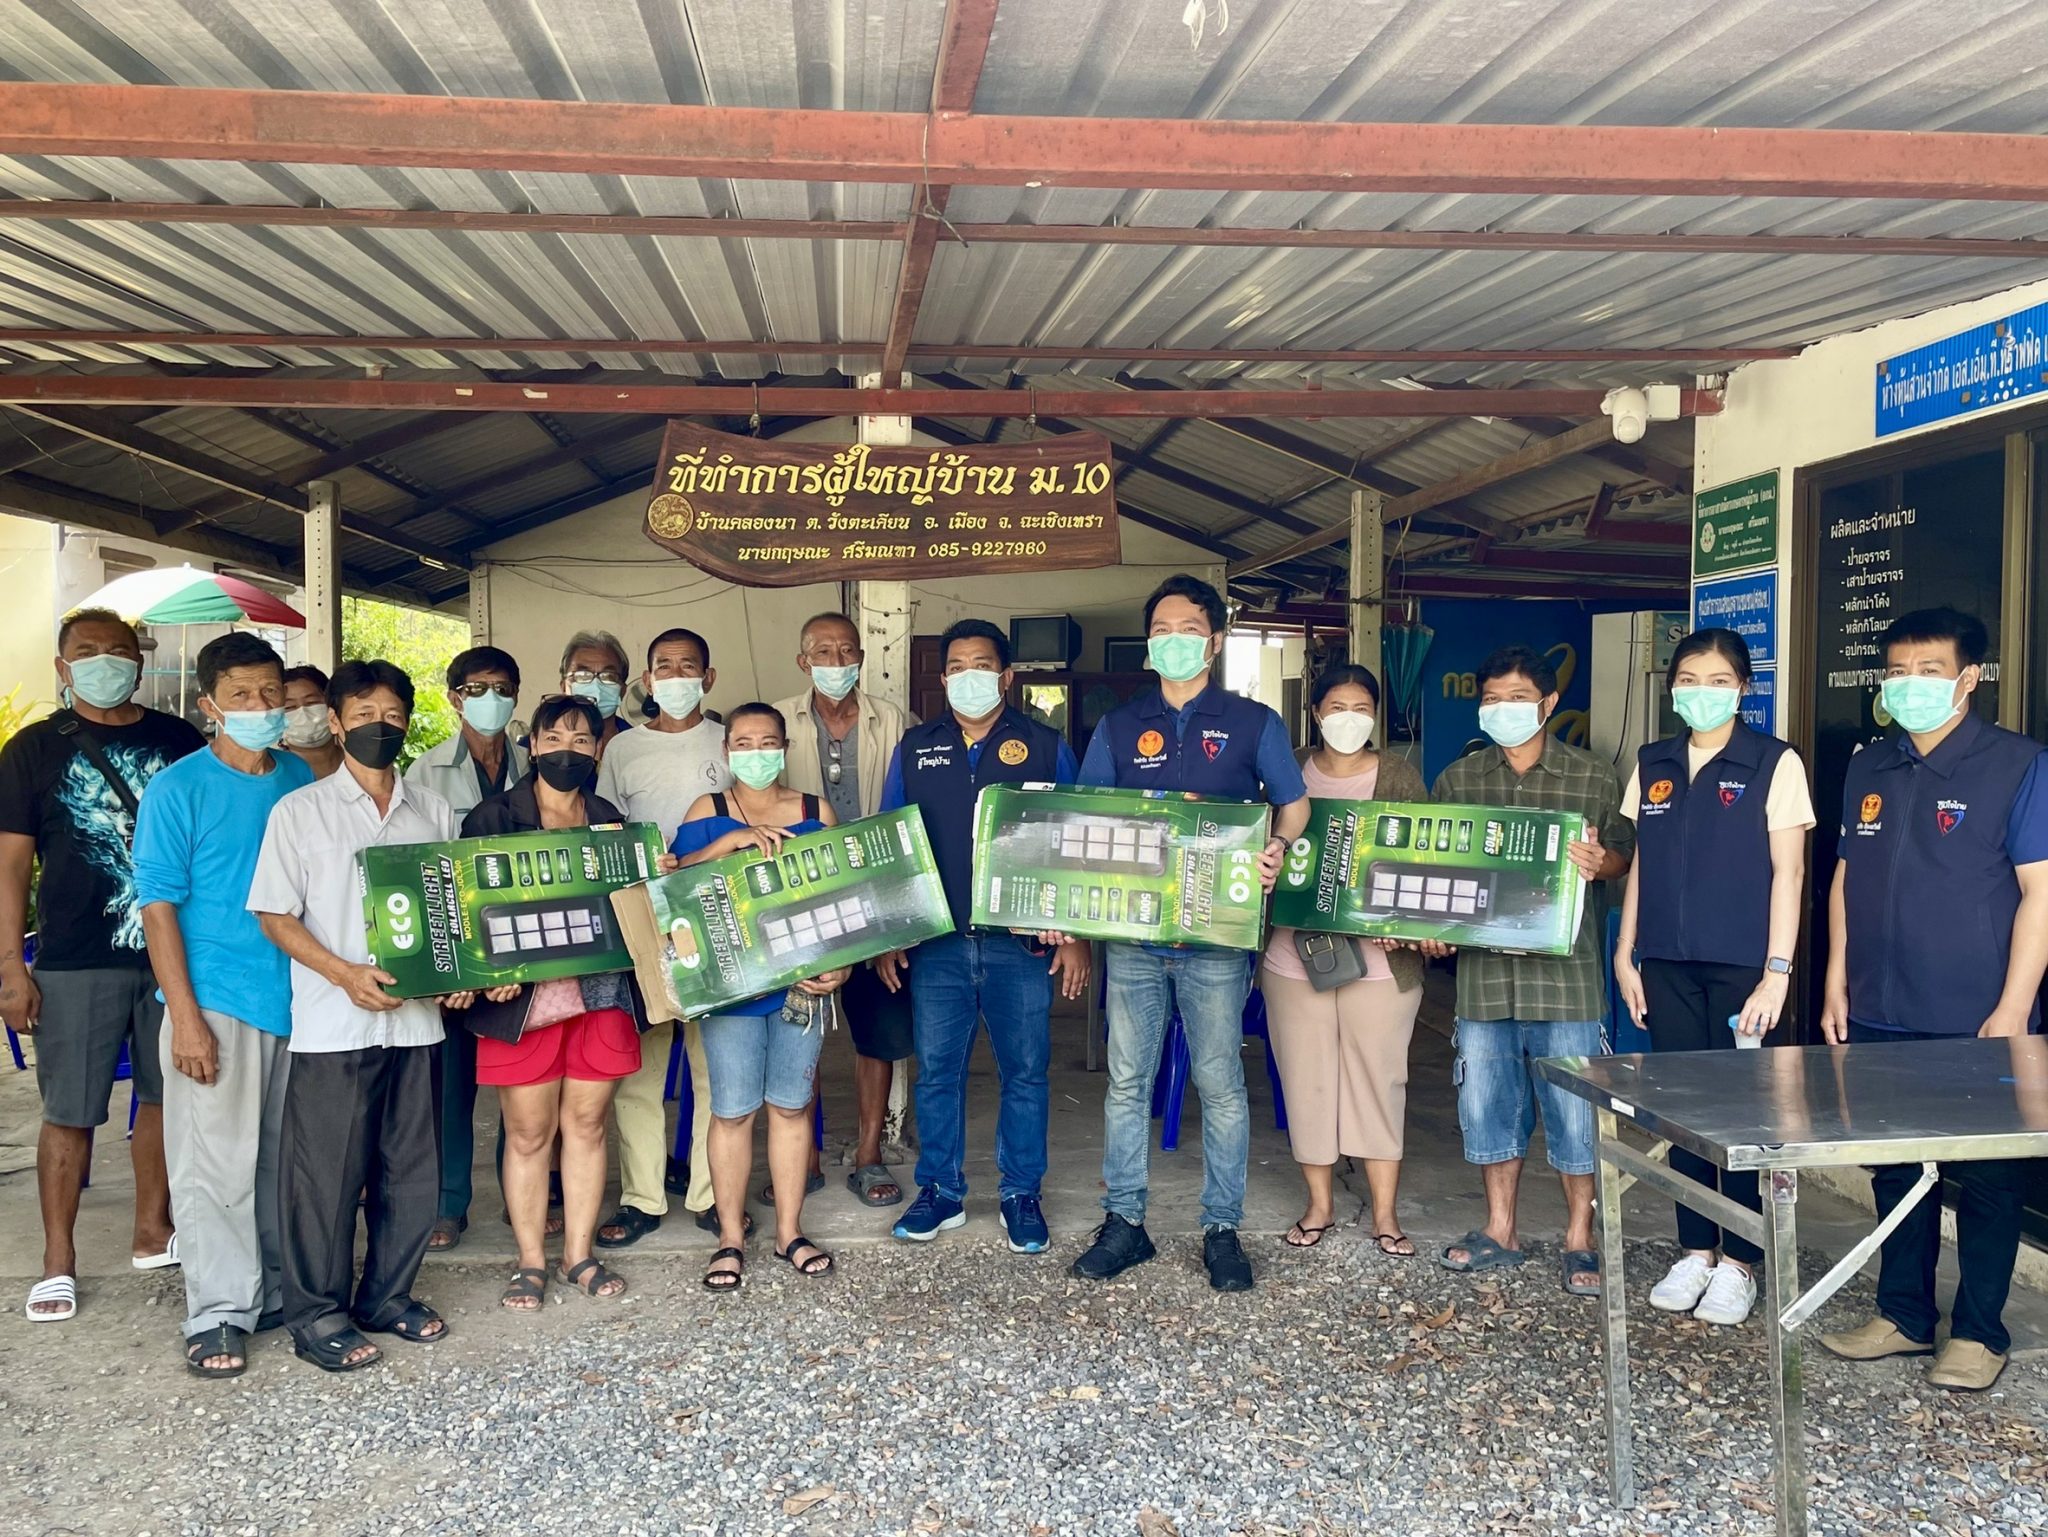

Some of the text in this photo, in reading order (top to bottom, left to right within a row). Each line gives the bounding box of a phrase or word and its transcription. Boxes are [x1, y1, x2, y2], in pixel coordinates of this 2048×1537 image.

[667, 443, 1111, 505] ที่ทำการผู้ใหญ่บ้าน ม. 10
[695, 510, 1104, 532] บ้านคลองนา ต. วังตะเคียน อ. เมือง จ. ฉะเชิงเทรา
[1831, 505, 1916, 540] ผลิตและจำหน่าย
[738, 540, 1047, 564] นายกฤษณะ ศรีมณฑา 085-9227960
[1845, 617, 1895, 635] หลักกิโลเม
[1845, 636, 1881, 661] อุปกรณ์
[1442, 672, 1477, 698] กอ
[1338, 815, 1355, 882] SOLARCELL LED
[1385, 818, 1400, 846] 500W
[1484, 821, 1498, 854] SOLAR
[581, 846, 595, 880] SOLAR
[843, 836, 861, 869] SOLAR
[1288, 838, 1311, 886] ECO
[1316, 815, 1343, 913] STREETLIGHT
[485, 856, 500, 888] 500W
[754, 865, 772, 894] 500W
[1229, 849, 1251, 903] ECO
[440, 860, 460, 935] SOLARCELL LED
[1046, 884, 1057, 918] SOLAR
[1183, 854, 1197, 926] SOLARCELL LED
[387, 893, 414, 949] ECO
[420, 862, 453, 972] STREETLIGHT
[713, 878, 741, 946] SOLARCELL LED
[1140, 892, 1152, 923] 500W
